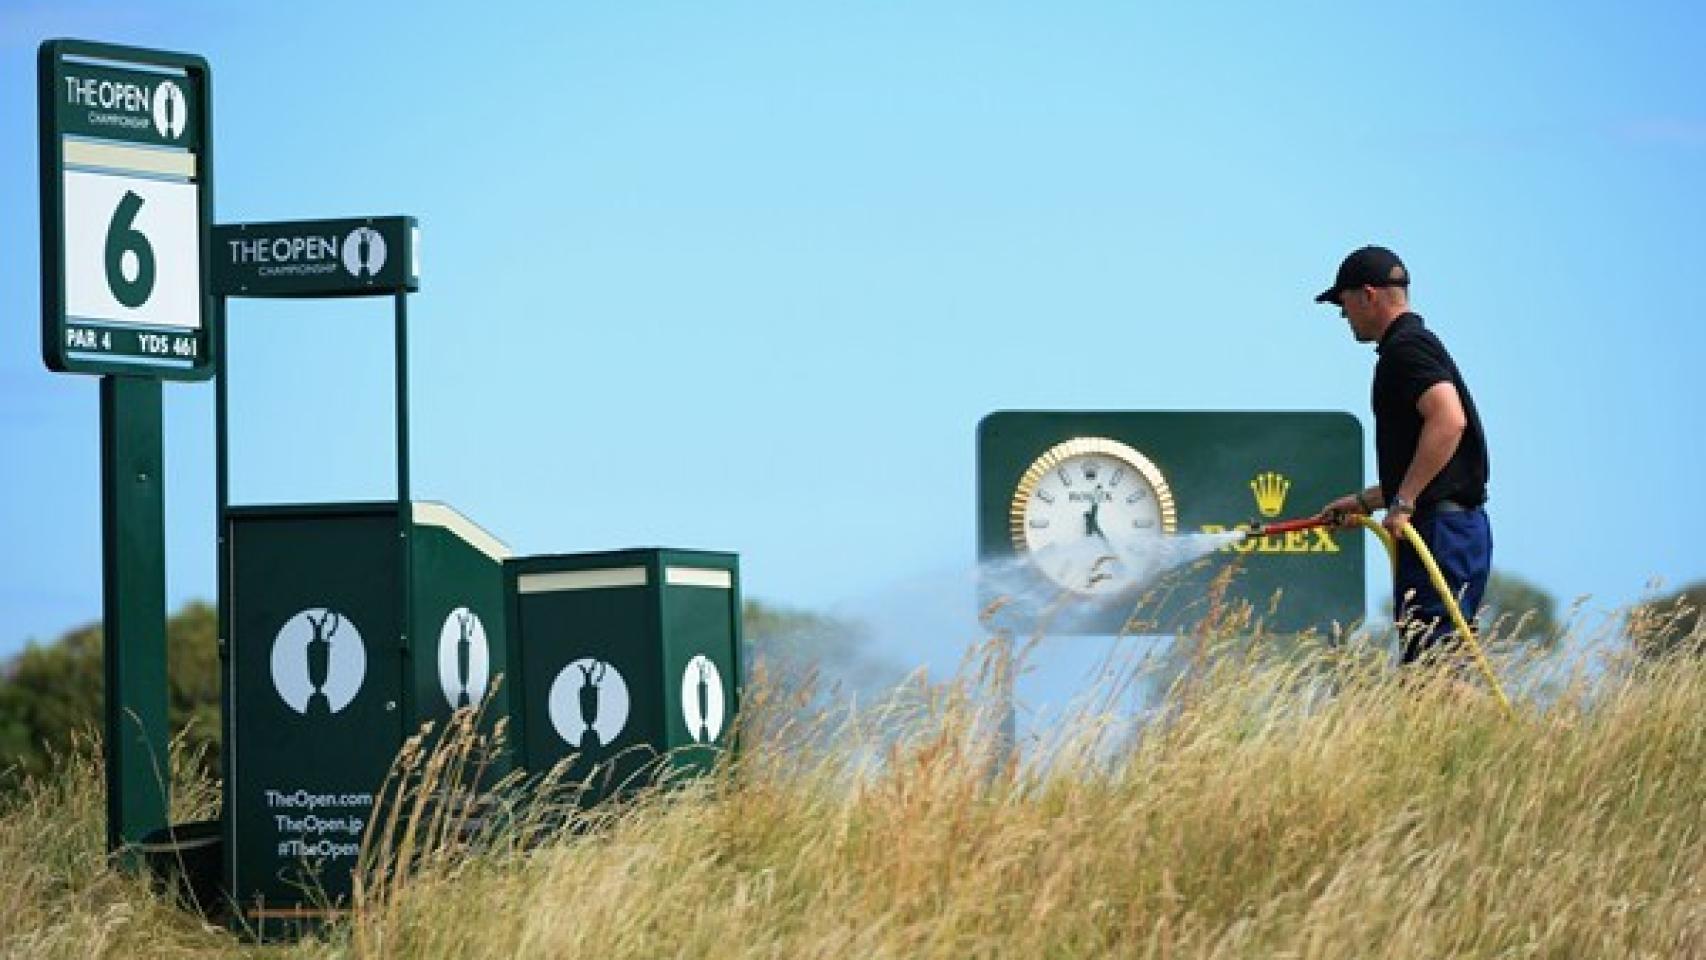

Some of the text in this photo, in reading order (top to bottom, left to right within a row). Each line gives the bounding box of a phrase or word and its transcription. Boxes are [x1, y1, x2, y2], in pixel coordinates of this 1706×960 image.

[65, 76, 149, 111] THE OPEN
[105, 189, 156, 308] 6
[229, 235, 337, 263] THE OPEN
[66, 328, 197, 356] PAR 4 YDS 461
[265, 789, 373, 811] TheOpen.com
[273, 814, 363, 835] TheOpen.jp
[278, 839, 359, 860] #TheOpen
